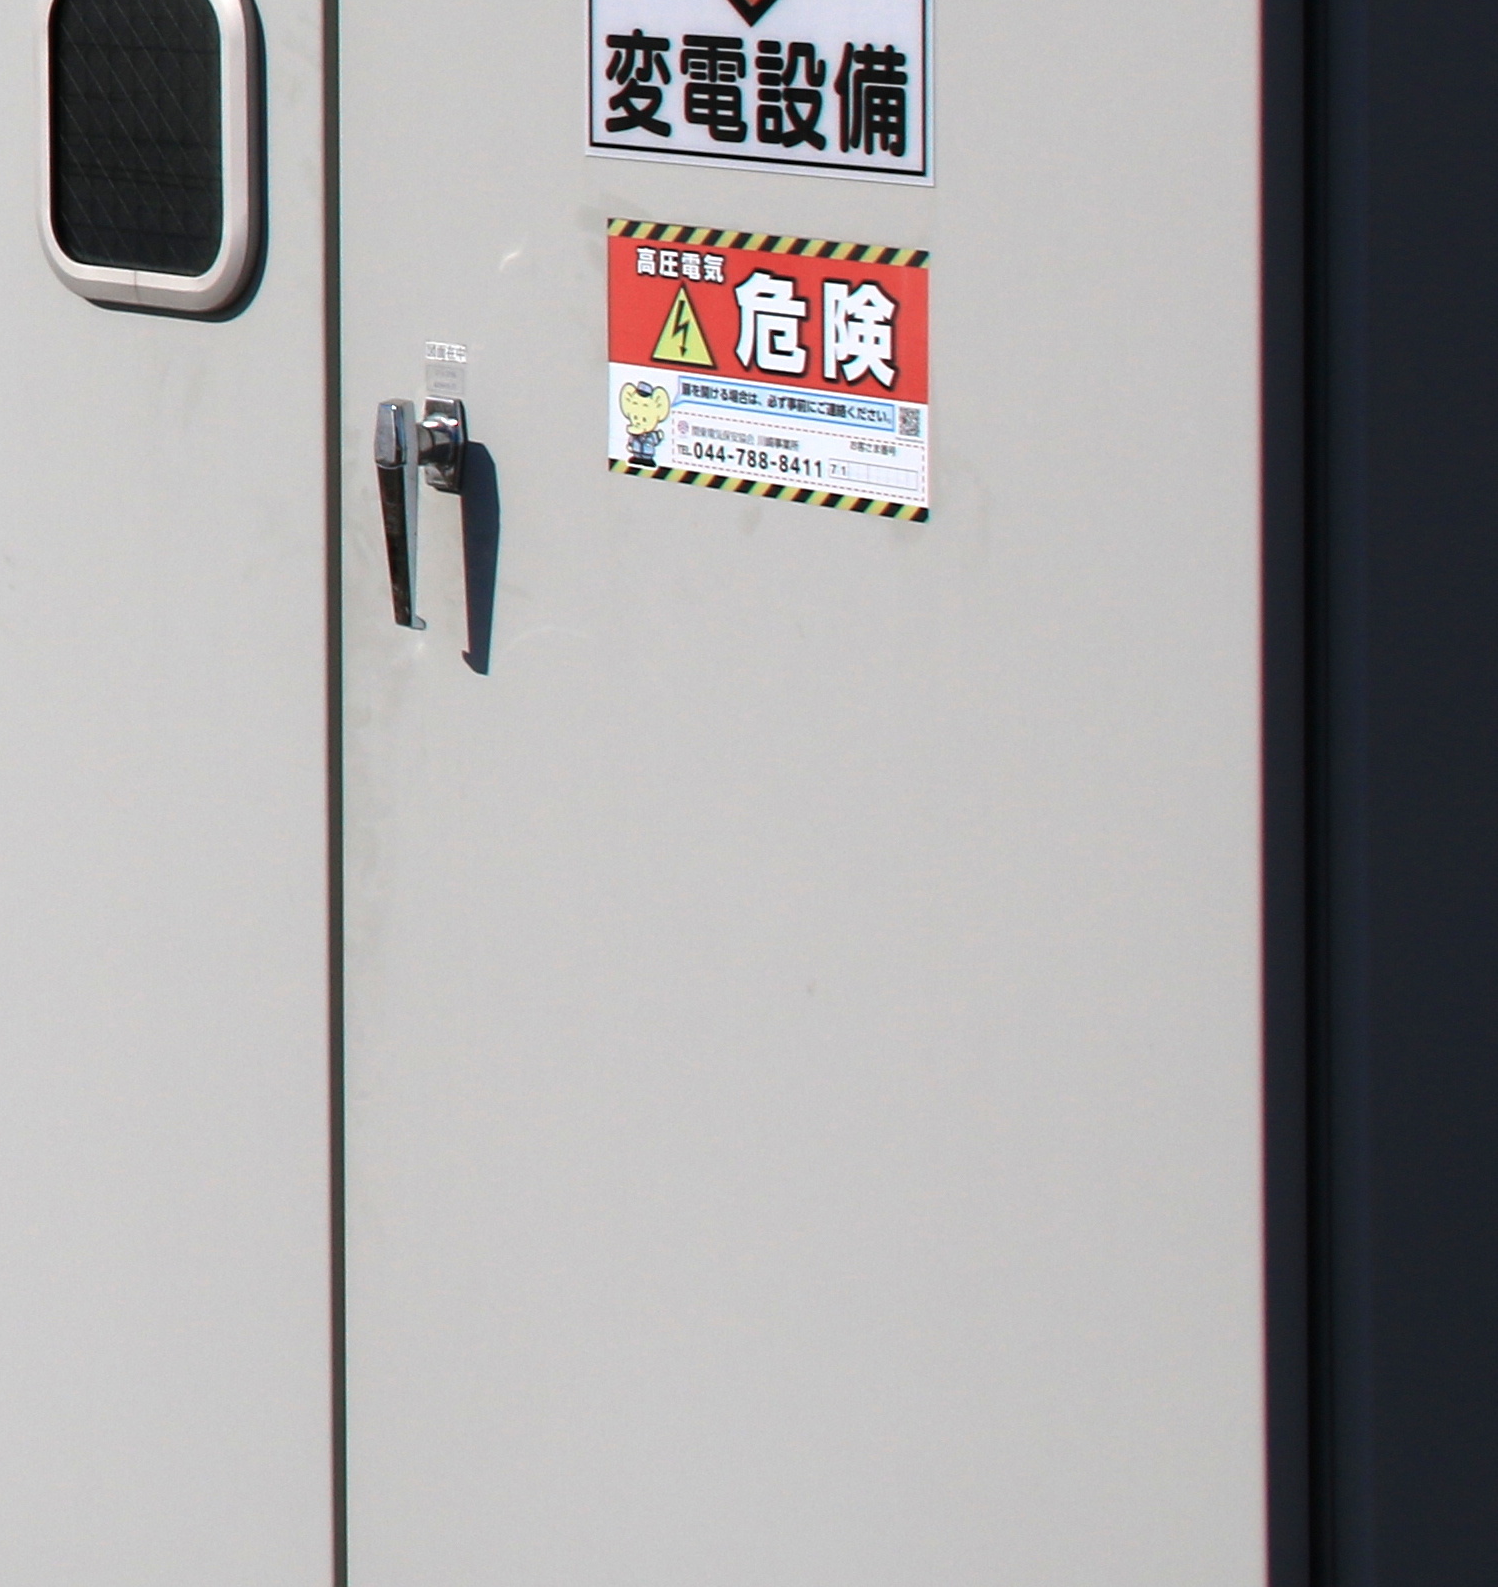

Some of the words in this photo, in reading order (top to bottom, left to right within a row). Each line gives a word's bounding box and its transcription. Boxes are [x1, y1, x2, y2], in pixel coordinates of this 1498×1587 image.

[605, 28, 907, 157] 変電設備
[635, 245, 726, 283] 高圧電気
[733, 270, 900, 388] 危険
[693, 441, 824, 479] 044-788-8411
